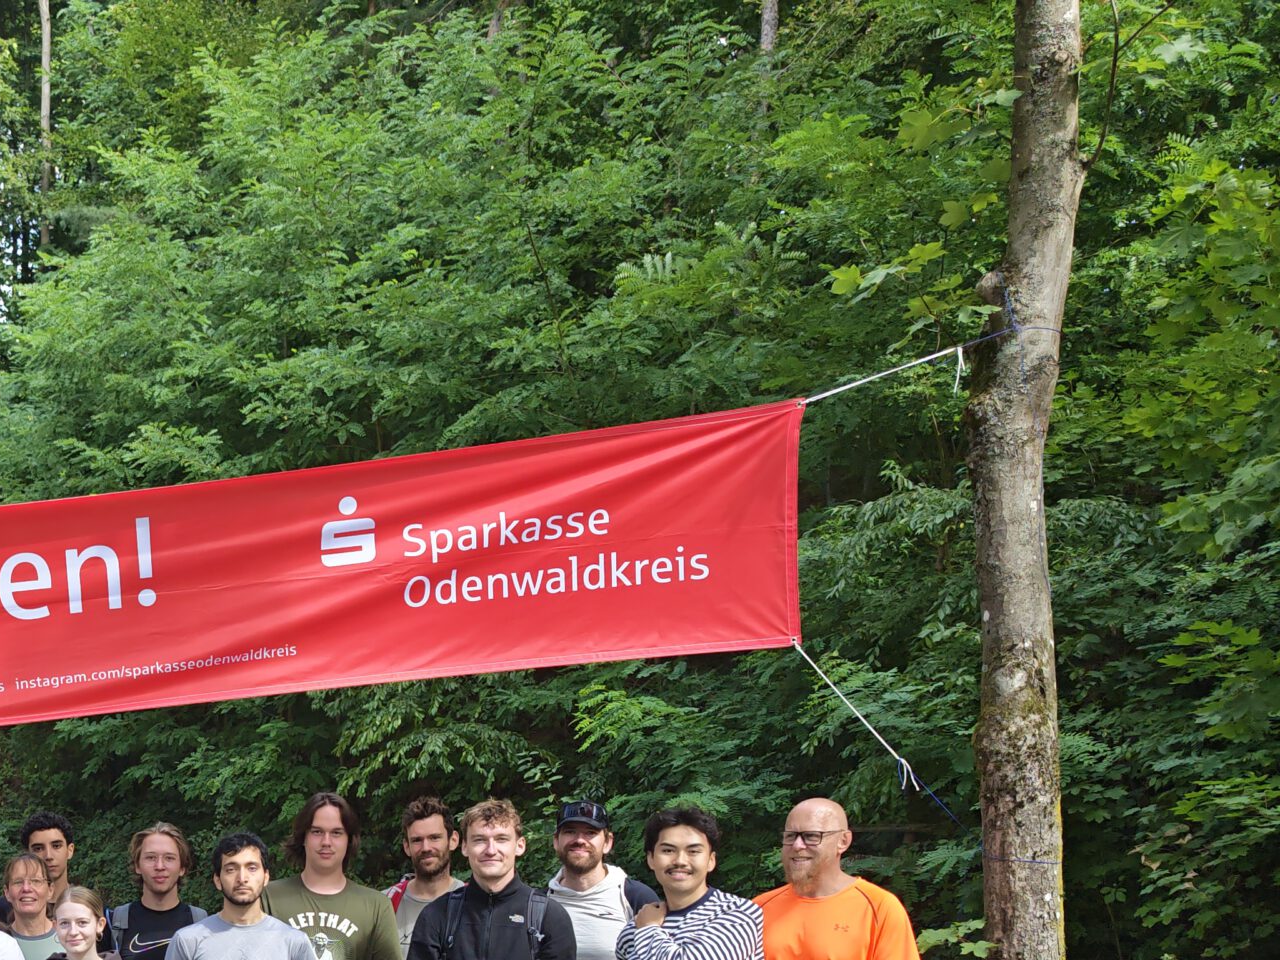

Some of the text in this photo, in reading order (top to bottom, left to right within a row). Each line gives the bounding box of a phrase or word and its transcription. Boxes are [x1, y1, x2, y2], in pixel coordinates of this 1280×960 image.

[402, 505, 610, 562] Sparkasse
[404, 545, 710, 608] Odenwaldkreis
[15, 644, 297, 690] instagram.com/sparkasseodenwaldkreis
[288, 912, 359, 938] LET THAT
